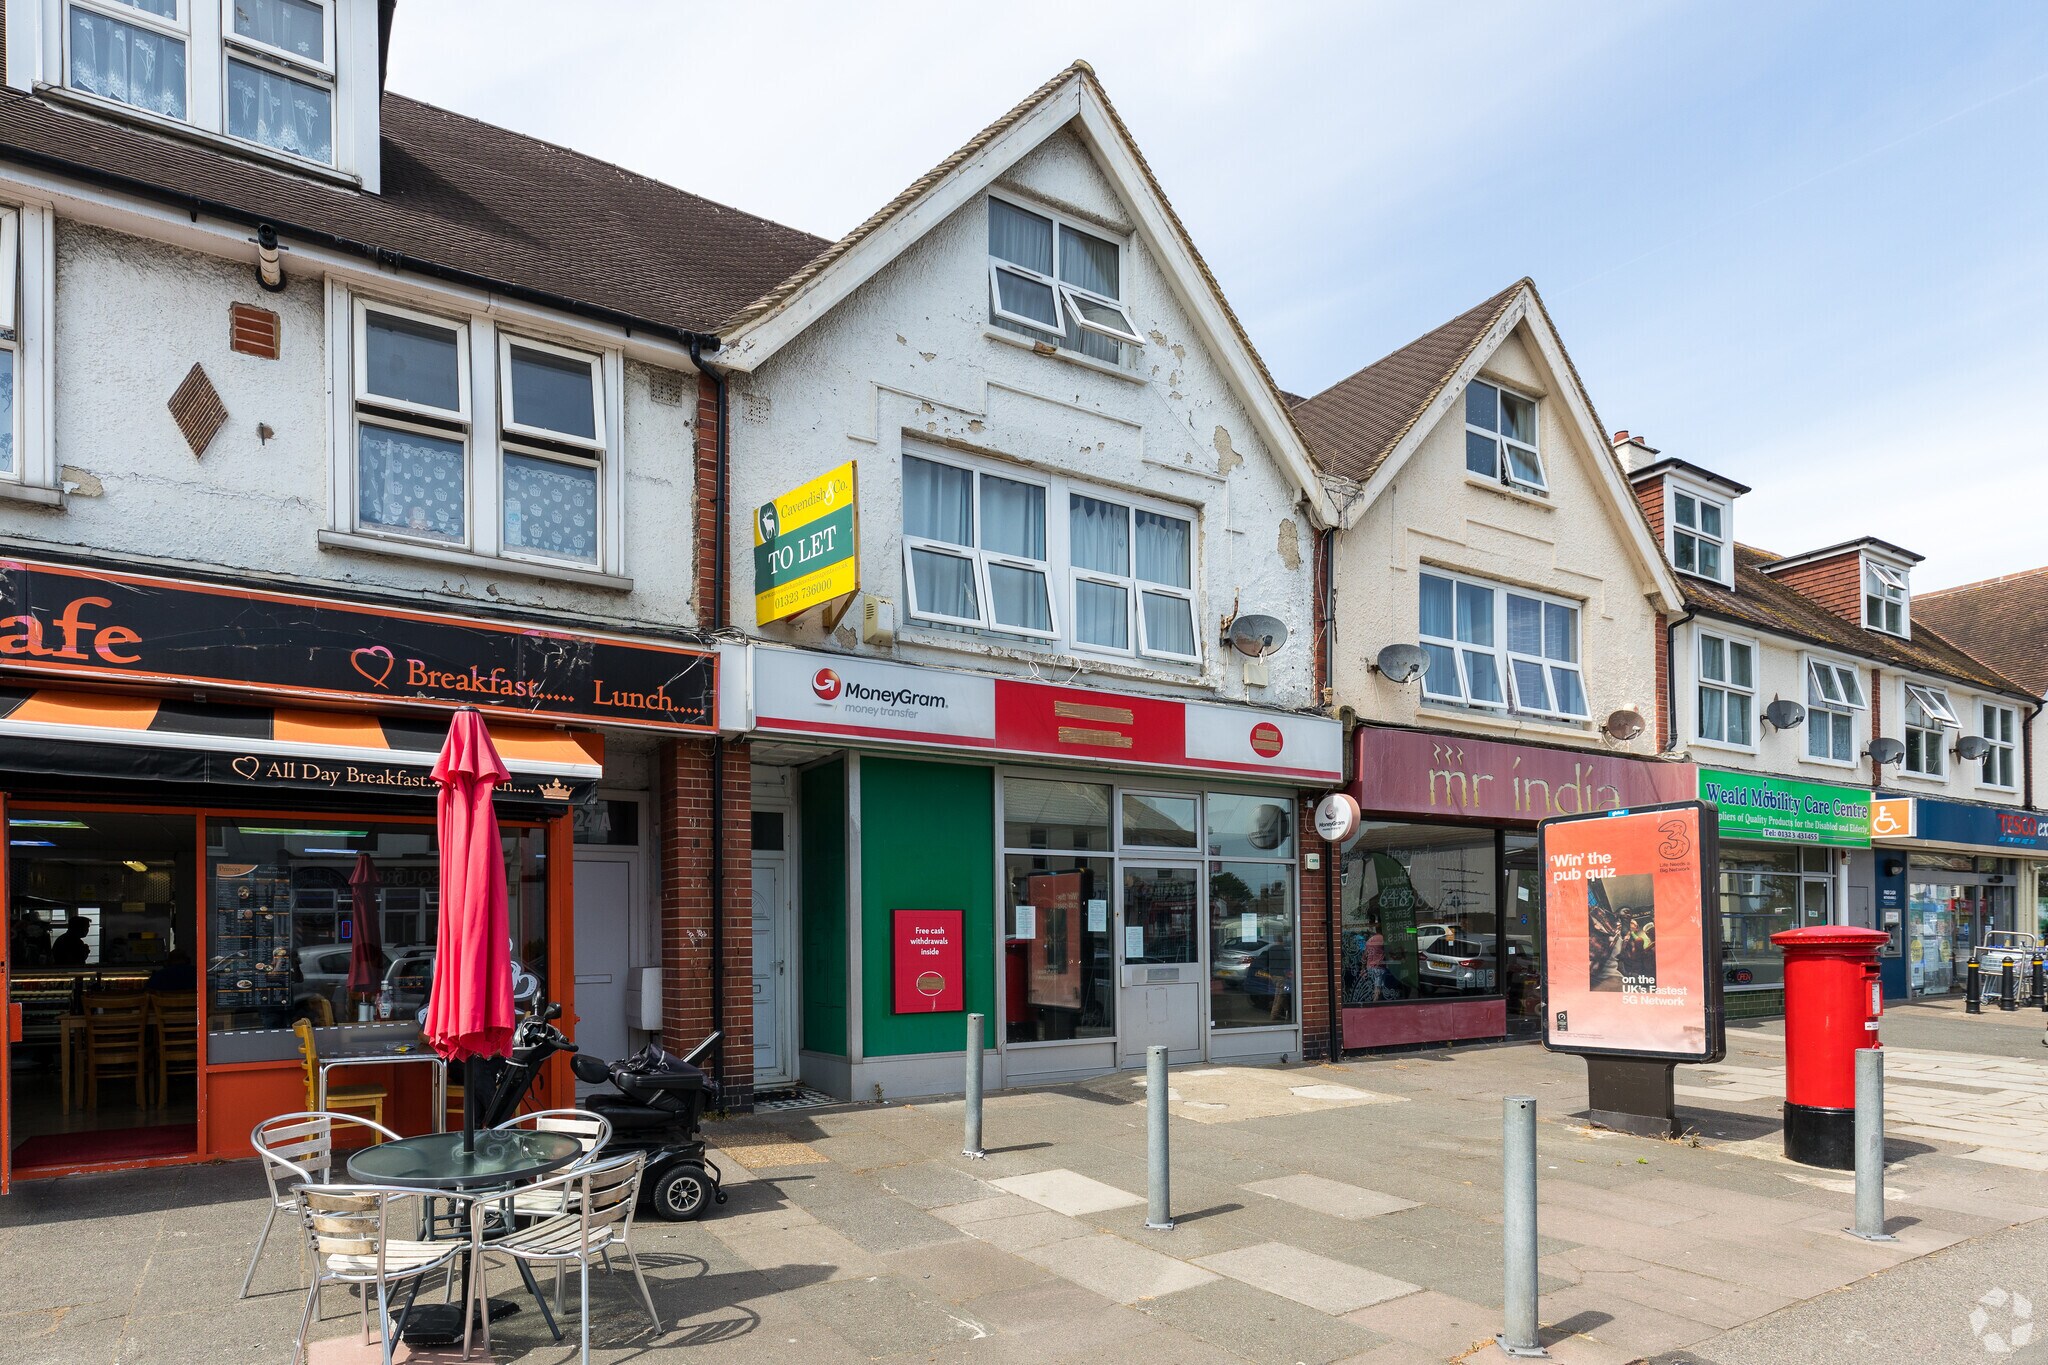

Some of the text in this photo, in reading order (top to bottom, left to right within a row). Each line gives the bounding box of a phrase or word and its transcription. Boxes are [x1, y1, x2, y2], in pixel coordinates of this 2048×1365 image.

[781, 487, 826, 518] Cavendish
[768, 525, 836, 575] TO LET
[774, 578, 832, 609] 01323 736000
[845, 682, 946, 708] MoneyGram
[844, 703, 918, 719] money transfer
[266, 761, 296, 779] All
[302, 763, 341, 787] Day
[1429, 756, 1621, 815] mr india
[1706, 783, 1868, 819] Weald Mobility Care Centre
[1737, 813, 1744, 823] of
[1745, 814, 1767, 827] Quality
[1768, 816, 1793, 828] Products
[1794, 818, 1803, 828] for
[1804, 820, 1814, 829] the
[1815, 821, 1838, 831] Disabled
[1838, 822, 1849, 832] and
[1997, 813, 2037, 837] TESCO
[1764, 829, 1818, 840] Tel: 01323 431455
[1587, 852, 1611, 865] the
[1553, 866, 1616, 884] pub quiz
[915, 927, 945, 935] Free cash
[910, 937, 949, 945] withdrawals
[920, 948, 939, 956] inside
[1622, 975, 1655, 984] on the
[1649, 985, 1687, 995] Fastest
[1622, 995, 1684, 1006] 5G Network
